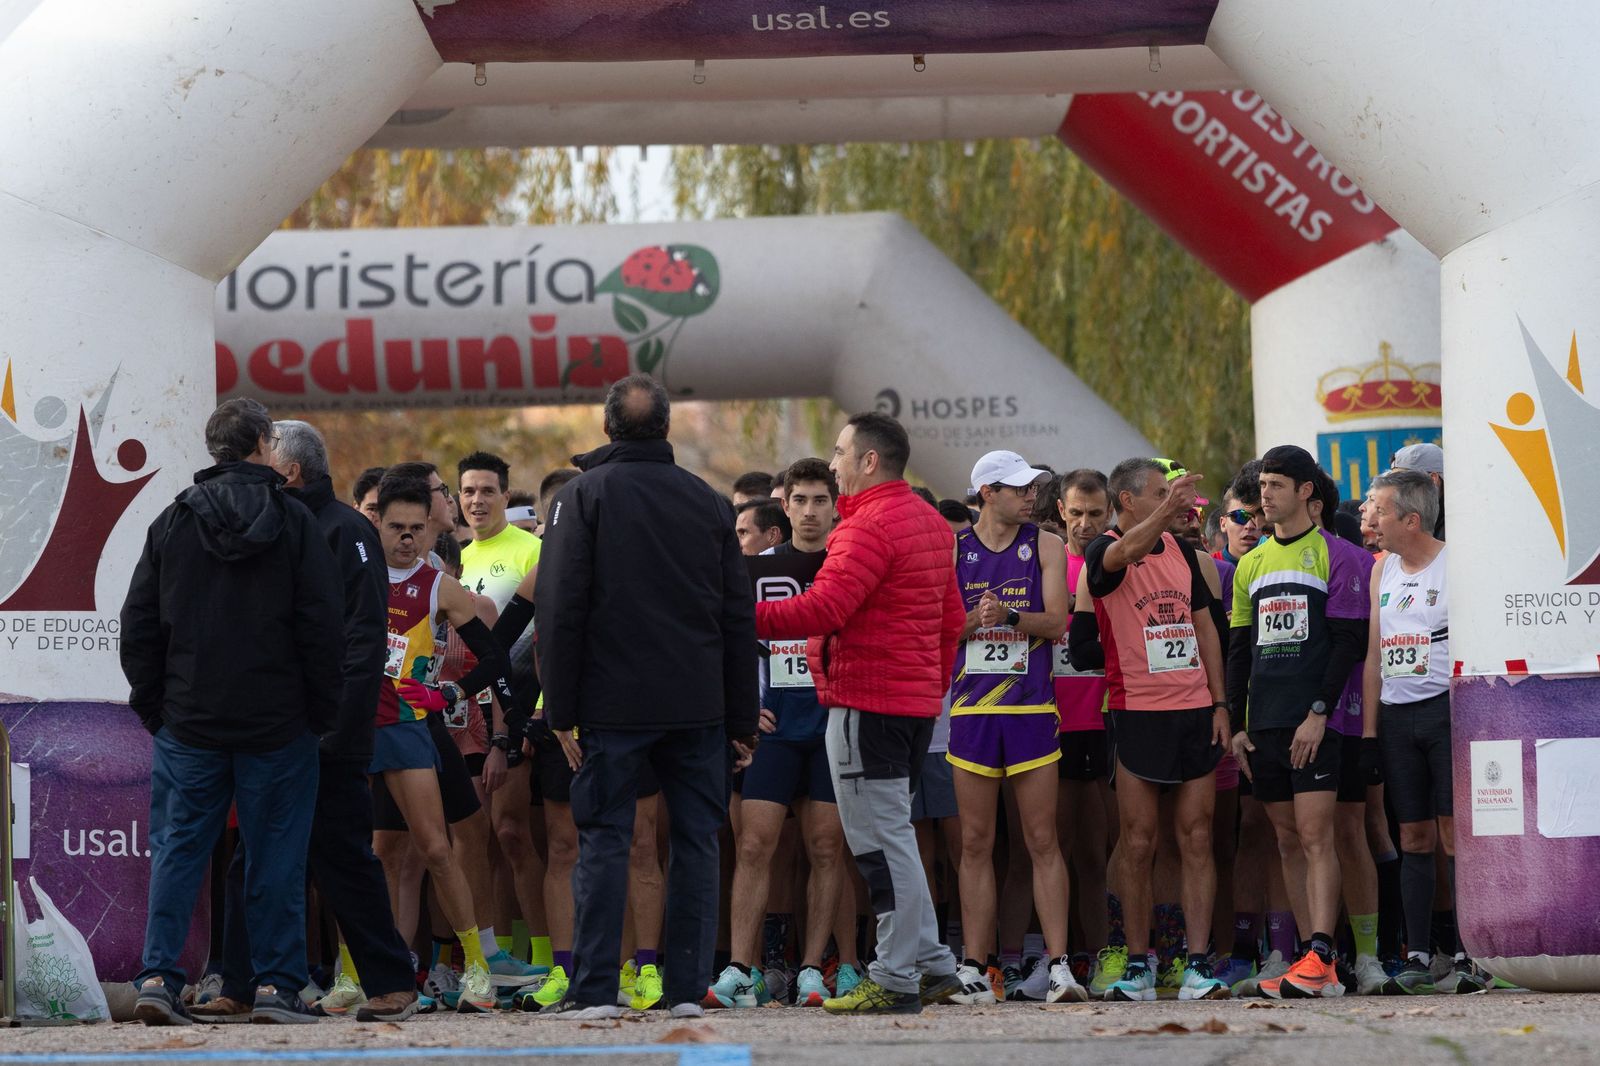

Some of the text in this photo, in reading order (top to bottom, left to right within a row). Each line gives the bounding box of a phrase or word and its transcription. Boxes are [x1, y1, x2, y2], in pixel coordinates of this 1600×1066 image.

[752, 5, 891, 31] usal.es
[1219, 89, 1376, 214] UESTROS
[1137, 90, 1333, 242] PORTISTAS
[227, 243, 596, 312] loristería
[911, 396, 1018, 419] HOSPES
[1002, 587, 1026, 595] PRIM
[1504, 591, 1582, 609] SERVICIO
[1158, 603, 1174, 613] RUN
[12, 618, 36, 632] DE
[43, 618, 120, 633] EDUCAC
[1159, 614, 1176, 624] CLUB
[1265, 613, 1295, 632] 940
[1505, 609, 1595, 626] FÍSICA Y
[1145, 627, 1195, 641] bedunia
[7, 636, 120, 651] Y DEPORT
[771, 643, 807, 656] bedu
[984, 643, 1009, 661] 23
[1164, 640, 1187, 659] 22
[1387, 647, 1417, 666] 333
[63, 820, 151, 858] usal.
